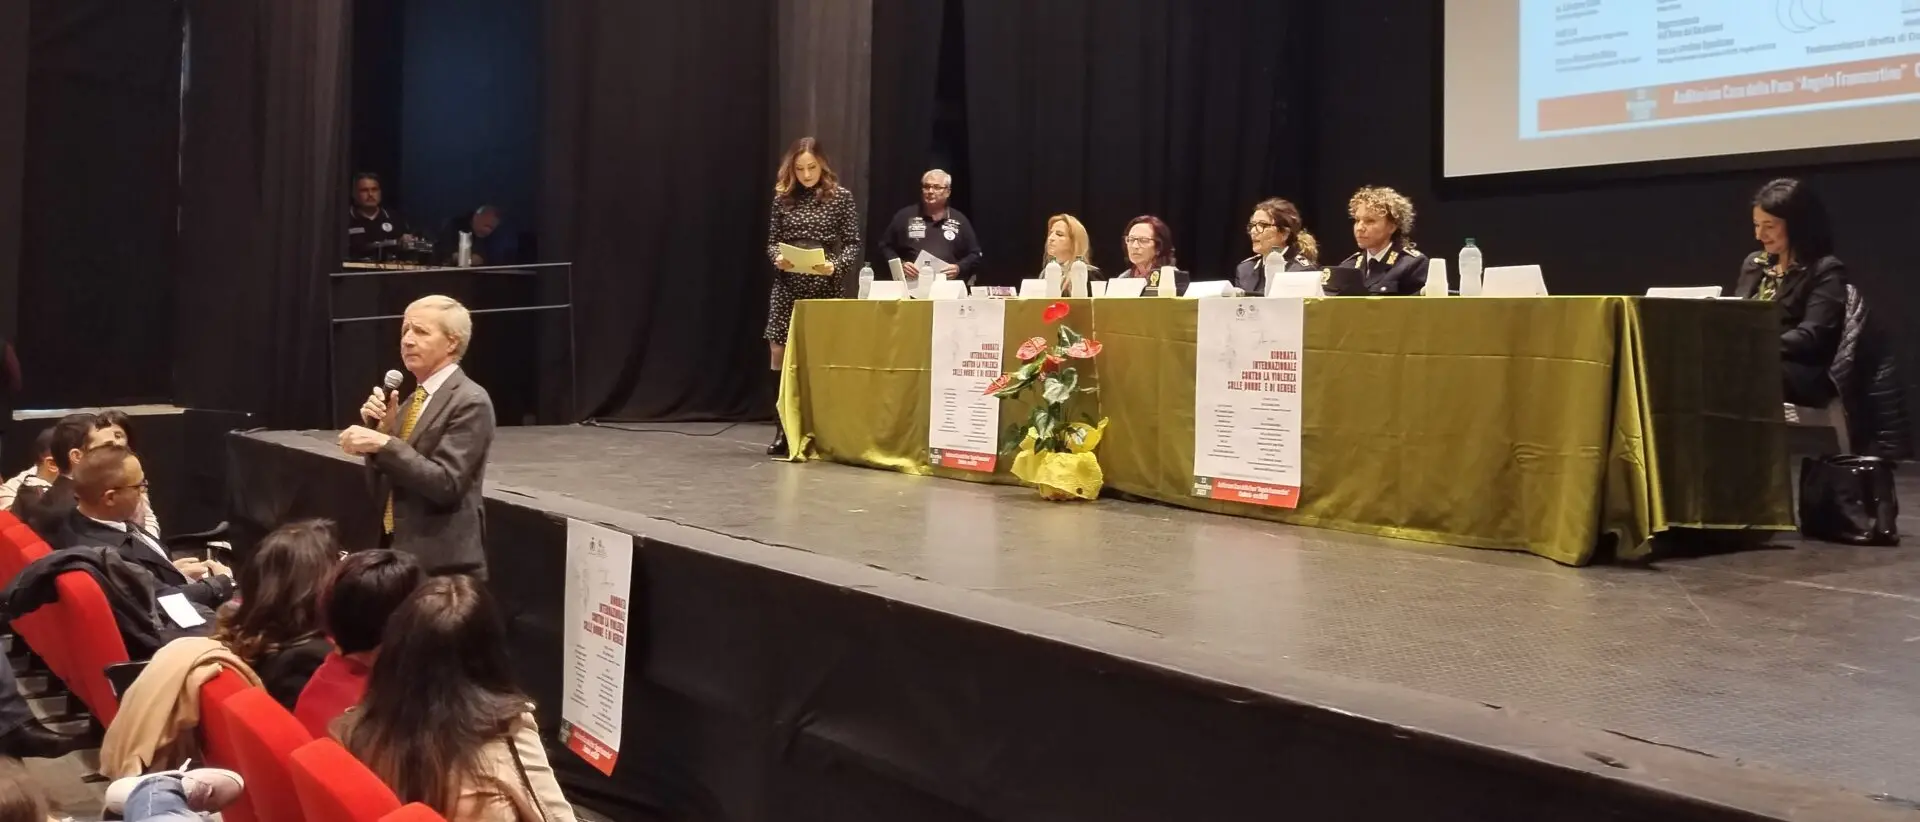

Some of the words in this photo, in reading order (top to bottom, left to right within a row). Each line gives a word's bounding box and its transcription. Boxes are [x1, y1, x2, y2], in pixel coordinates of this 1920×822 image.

[1270, 350, 1297, 360] GIORNATA
[1252, 360, 1297, 371] INTERNAZIONALE
[1241, 371, 1262, 380] CONTRO
[1271, 372, 1297, 382] VIOLENZA
[1227, 381, 1243, 390] SULLE
[1243, 381, 1261, 391] DONNE
[1276, 383, 1297, 393] GENERE
